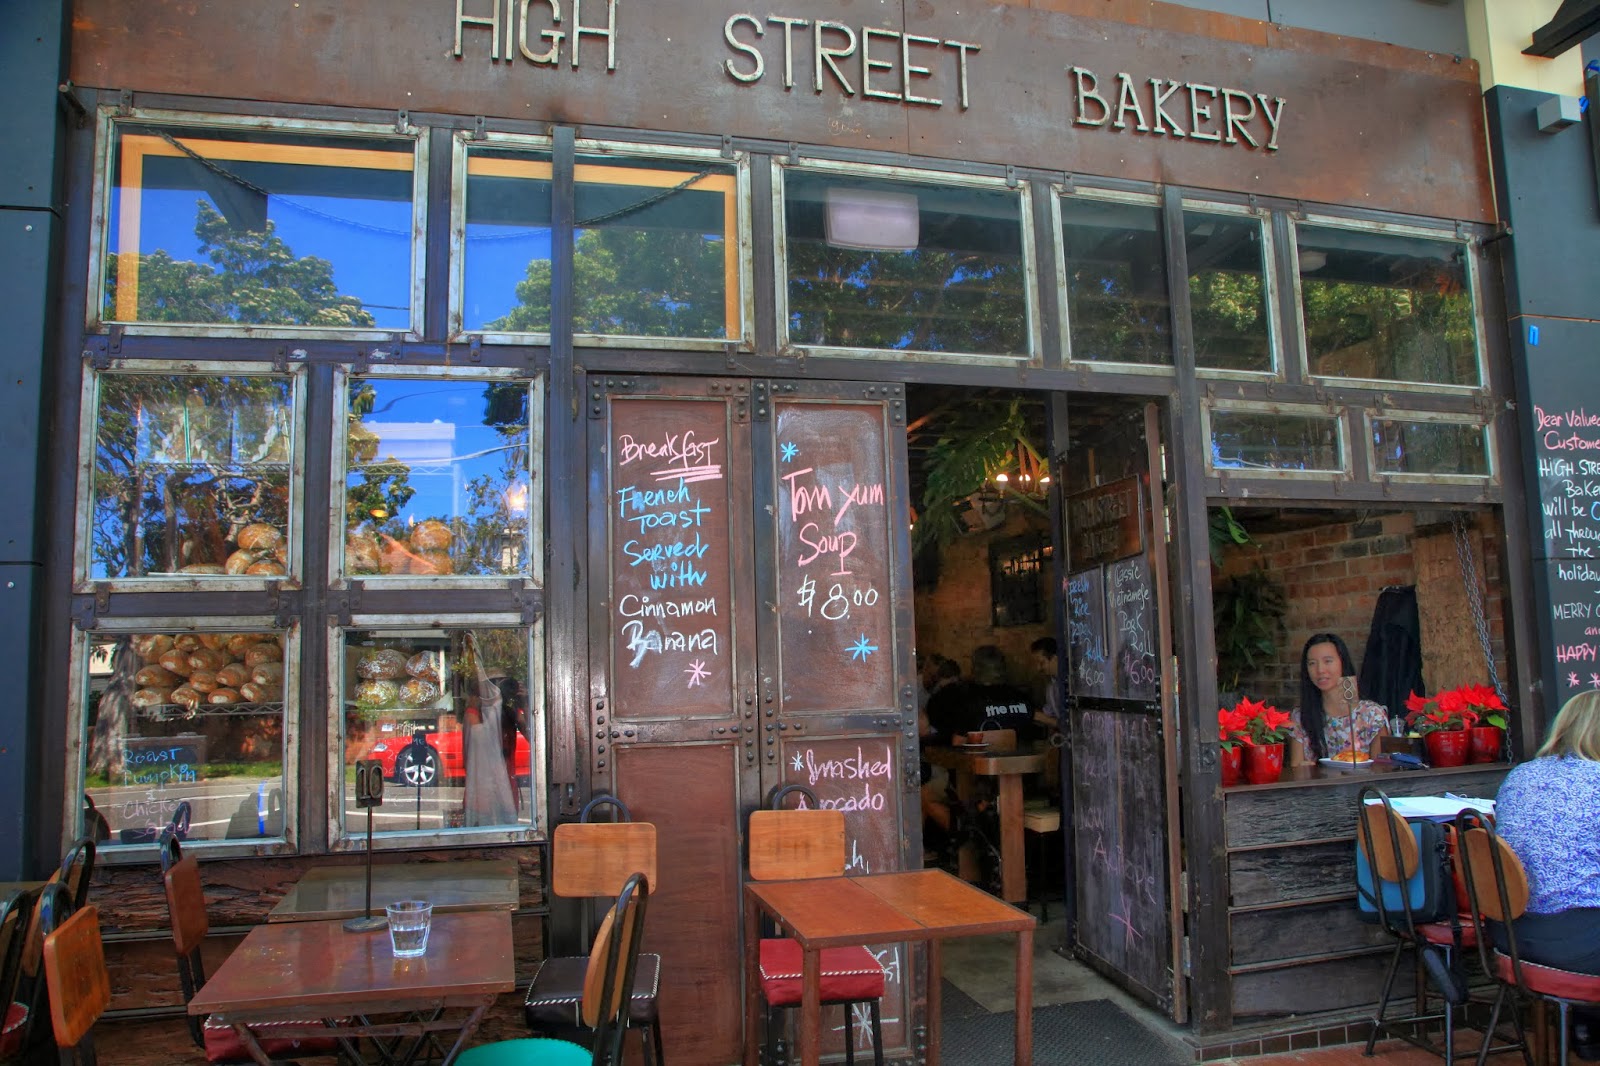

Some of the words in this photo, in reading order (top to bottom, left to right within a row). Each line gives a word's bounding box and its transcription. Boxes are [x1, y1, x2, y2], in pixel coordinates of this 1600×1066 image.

[453, 0, 616, 71] HIGH
[723, 13, 982, 111] STREET
[1069, 66, 1286, 151] BAKERY
[1533, 404, 1563, 431] Dear
[1542, 496, 1567, 516] will
[1571, 499, 1588, 517] be
[1544, 520, 1562, 540] all
[798, 522, 857, 576] Soup
[1564, 541, 1595, 558] the
[619, 595, 718, 619] Cinnamon
[1553, 602, 1592, 620] MERRY
[621, 619, 718, 668] Banana
[1556, 642, 1597, 664] HAPPY
[1343, 677, 1353, 700] 8
[985, 705, 1007, 718] the
[123, 747, 182, 764] Roast
[357, 764, 384, 800] 10
